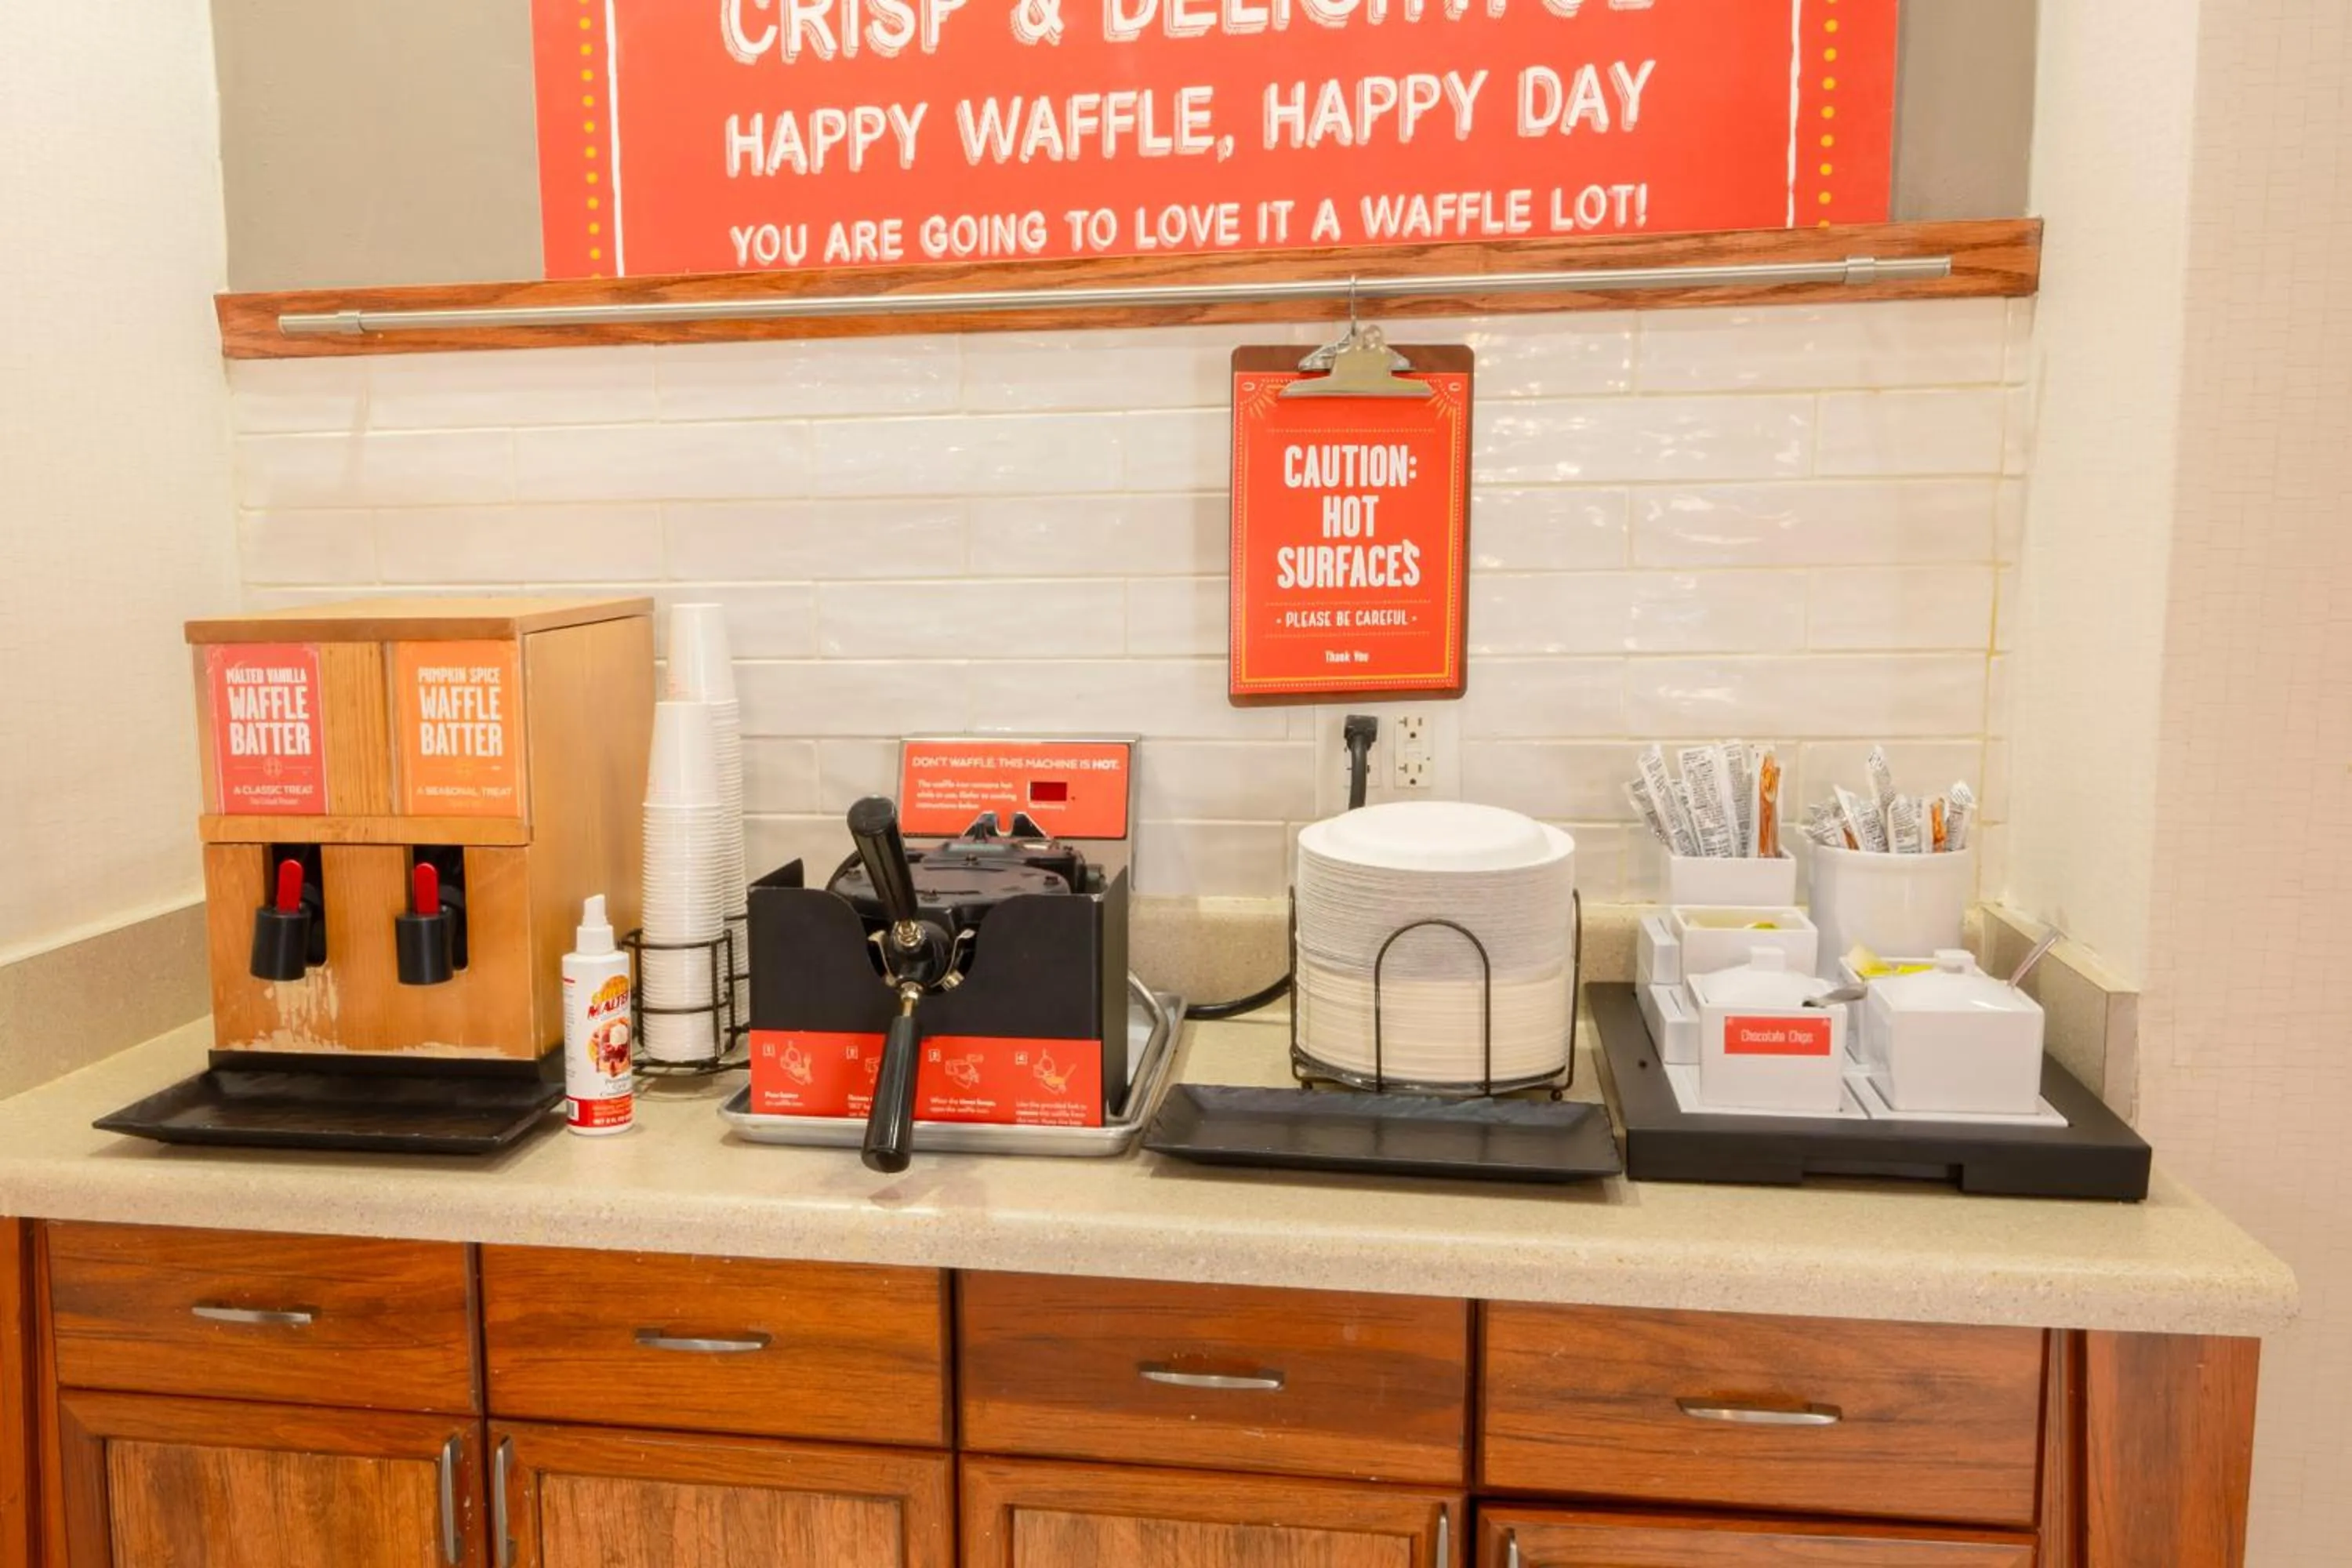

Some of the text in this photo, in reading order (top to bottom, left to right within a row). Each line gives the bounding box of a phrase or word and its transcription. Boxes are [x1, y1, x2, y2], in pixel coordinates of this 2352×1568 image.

[726, 60, 1657, 178] HAPPY WAFFLE, HAPPY DAY
[730, 182, 1650, 267] YOU ARE GOING TO LOVE IT A WAFFLE LOT!
[1283, 445, 1417, 488] CAUTION:
[1323, 495, 1379, 538] HOT
[1277, 544, 1421, 589] SURFACES
[1286, 609, 1408, 627] PLEASE BE CAREFUL
[1325, 651, 1369, 662] Thank You
[226, 667, 307, 684] MALTED VANILLA
[418, 666, 501, 684] PUMPKIN SPICE
[227, 686, 310, 720] WAFFLE
[419, 686, 502, 720] WAFFLE
[230, 722, 311, 756] BATTER
[420, 722, 503, 757] BATTER
[912, 756, 947, 768] DON'T
[999, 757, 1023, 768] THIS
[1025, 757, 1078, 769] MACHINE
[1080, 760, 1091, 769] IS
[242, 785, 282, 794] CLASSIC
[284, 785, 313, 793] TREAT
[1740, 1029, 1813, 1046] Chocolate Chips
